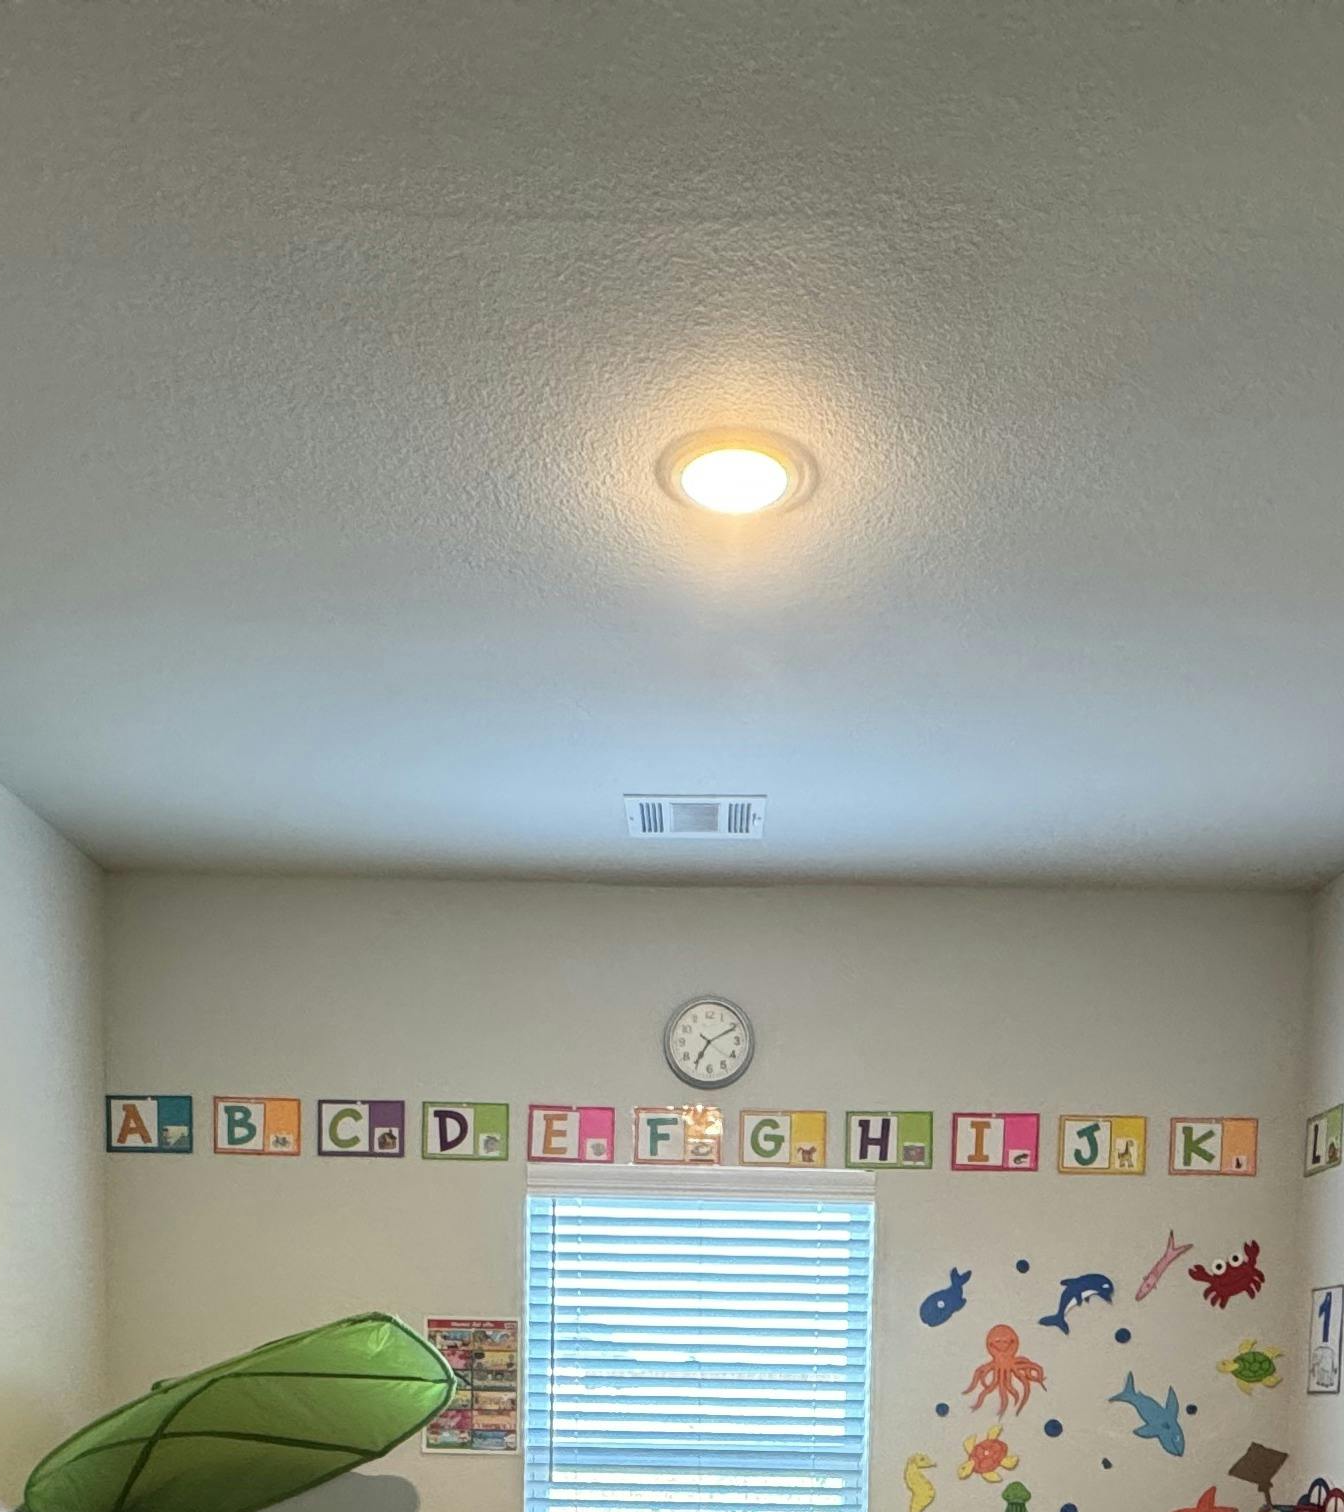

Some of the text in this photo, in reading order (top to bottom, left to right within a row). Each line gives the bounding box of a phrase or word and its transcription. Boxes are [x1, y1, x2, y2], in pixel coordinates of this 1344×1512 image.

[682, 1025, 692, 1034] 10
[705, 1011, 715, 1020] 12
[679, 1038, 685, 1047] 9
[683, 1052, 690, 1061] 8
[729, 1050, 736, 1059] 4
[734, 1036, 740, 1046] 3
[706, 1064, 713, 1073] 6
[720, 1060, 727, 1070] 5
[116, 1103, 153, 1144] A
[224, 1105, 257, 1146] B
[328, 1108, 363, 1149] C
[434, 1110, 469, 1152] D
[542, 1113, 568, 1155] E
[646, 1117, 679, 1157] F
[750, 1118, 785, 1158] G
[858, 1118, 891, 1161] H
[968, 1120, 992, 1163] I
[1073, 1122, 1101, 1166] J
[1311, 1123, 1321, 1165] L
[1182, 1126, 1216, 1167] K
[1318, 1291, 1332, 1342] 1
